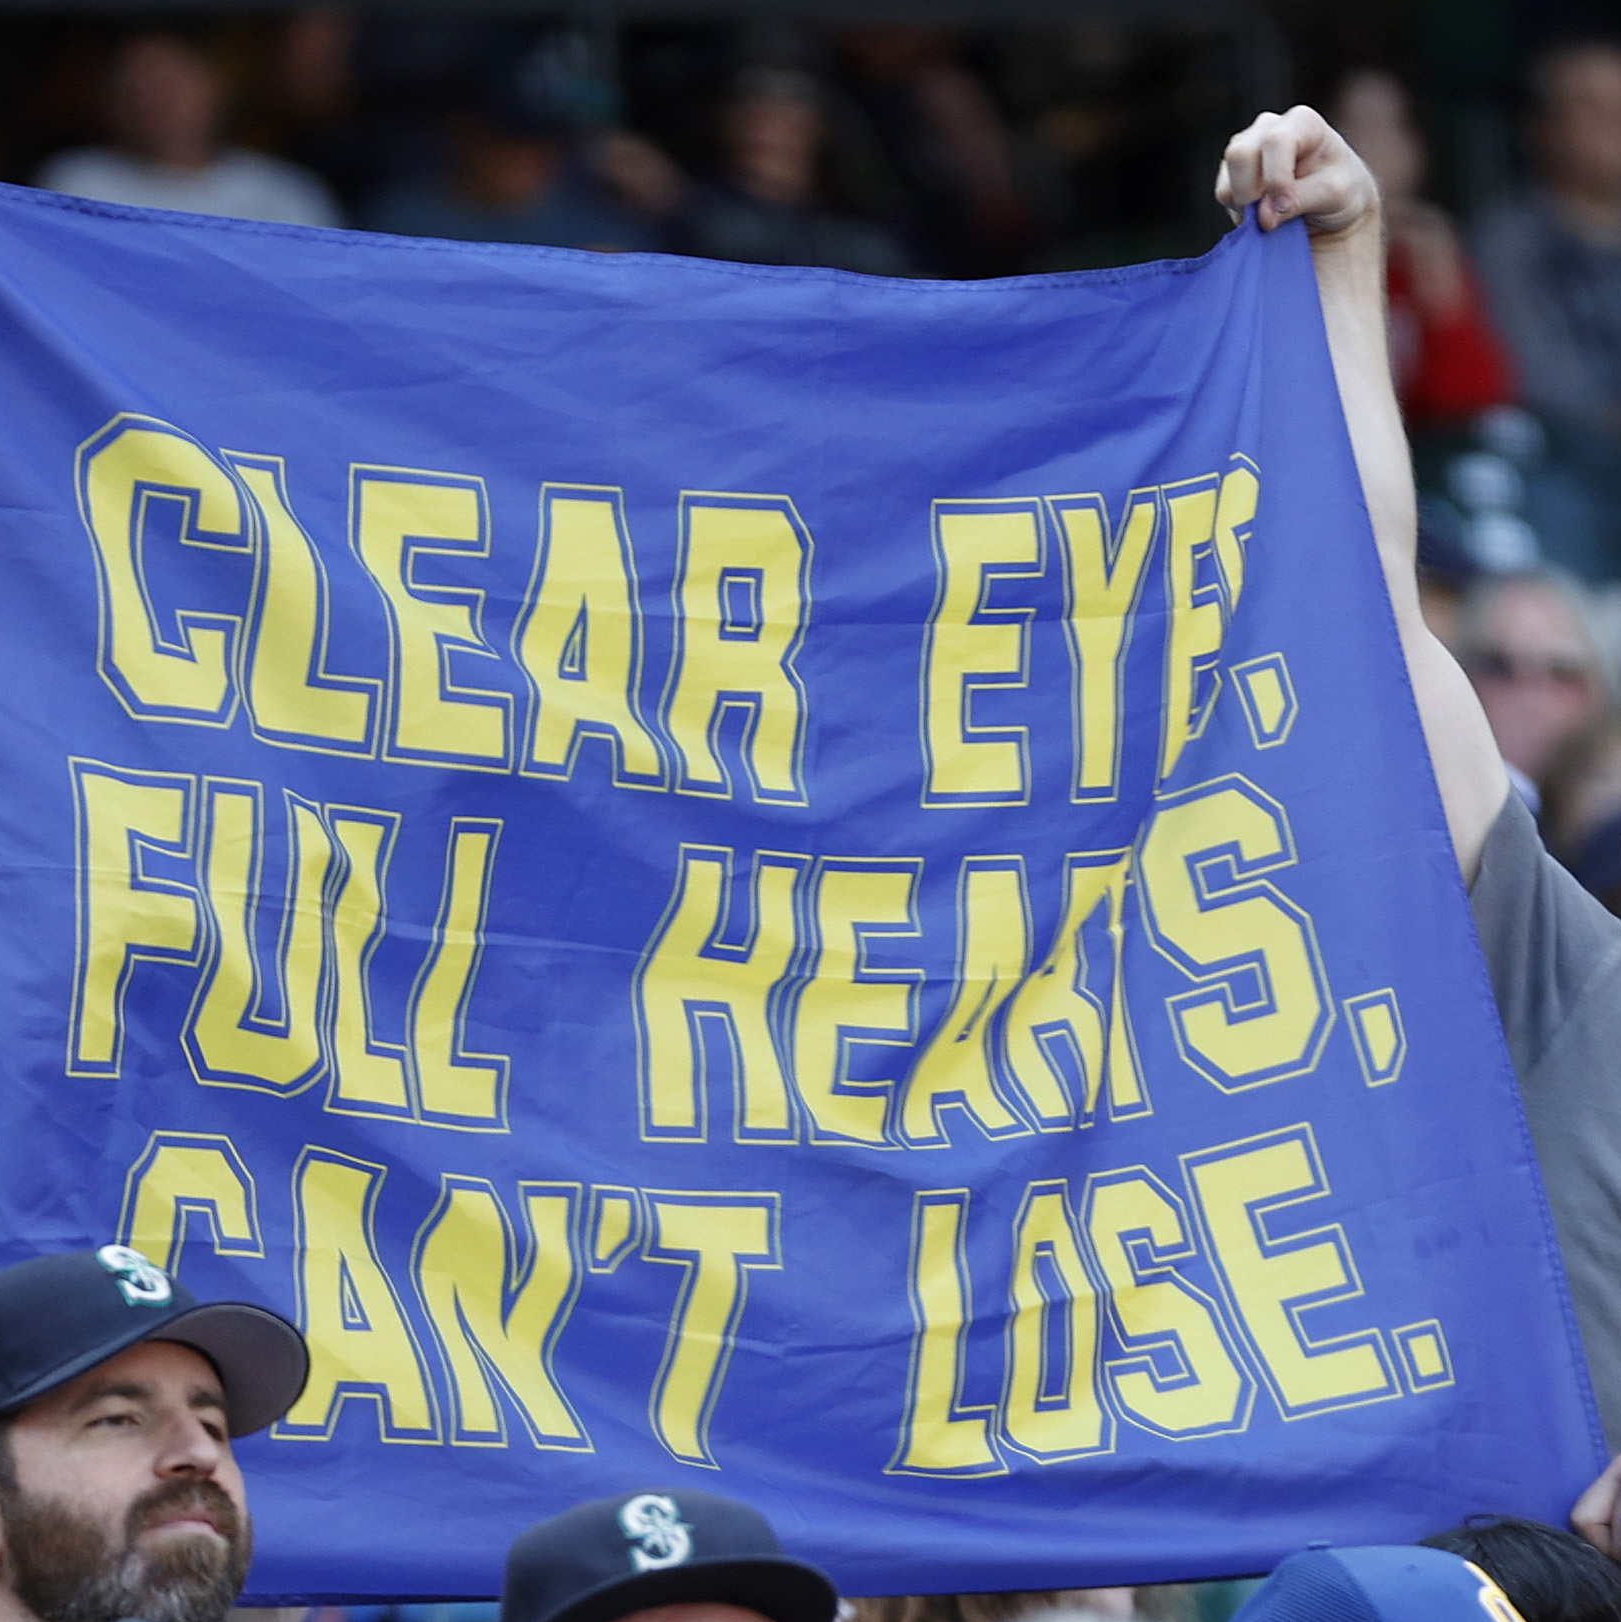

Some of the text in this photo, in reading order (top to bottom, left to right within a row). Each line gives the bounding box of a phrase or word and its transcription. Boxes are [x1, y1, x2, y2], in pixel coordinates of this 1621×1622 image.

[73, 411, 814, 807] CLEAR
[65, 755, 512, 1135] FULL
[882, 1121, 1457, 1481] LOSE.
